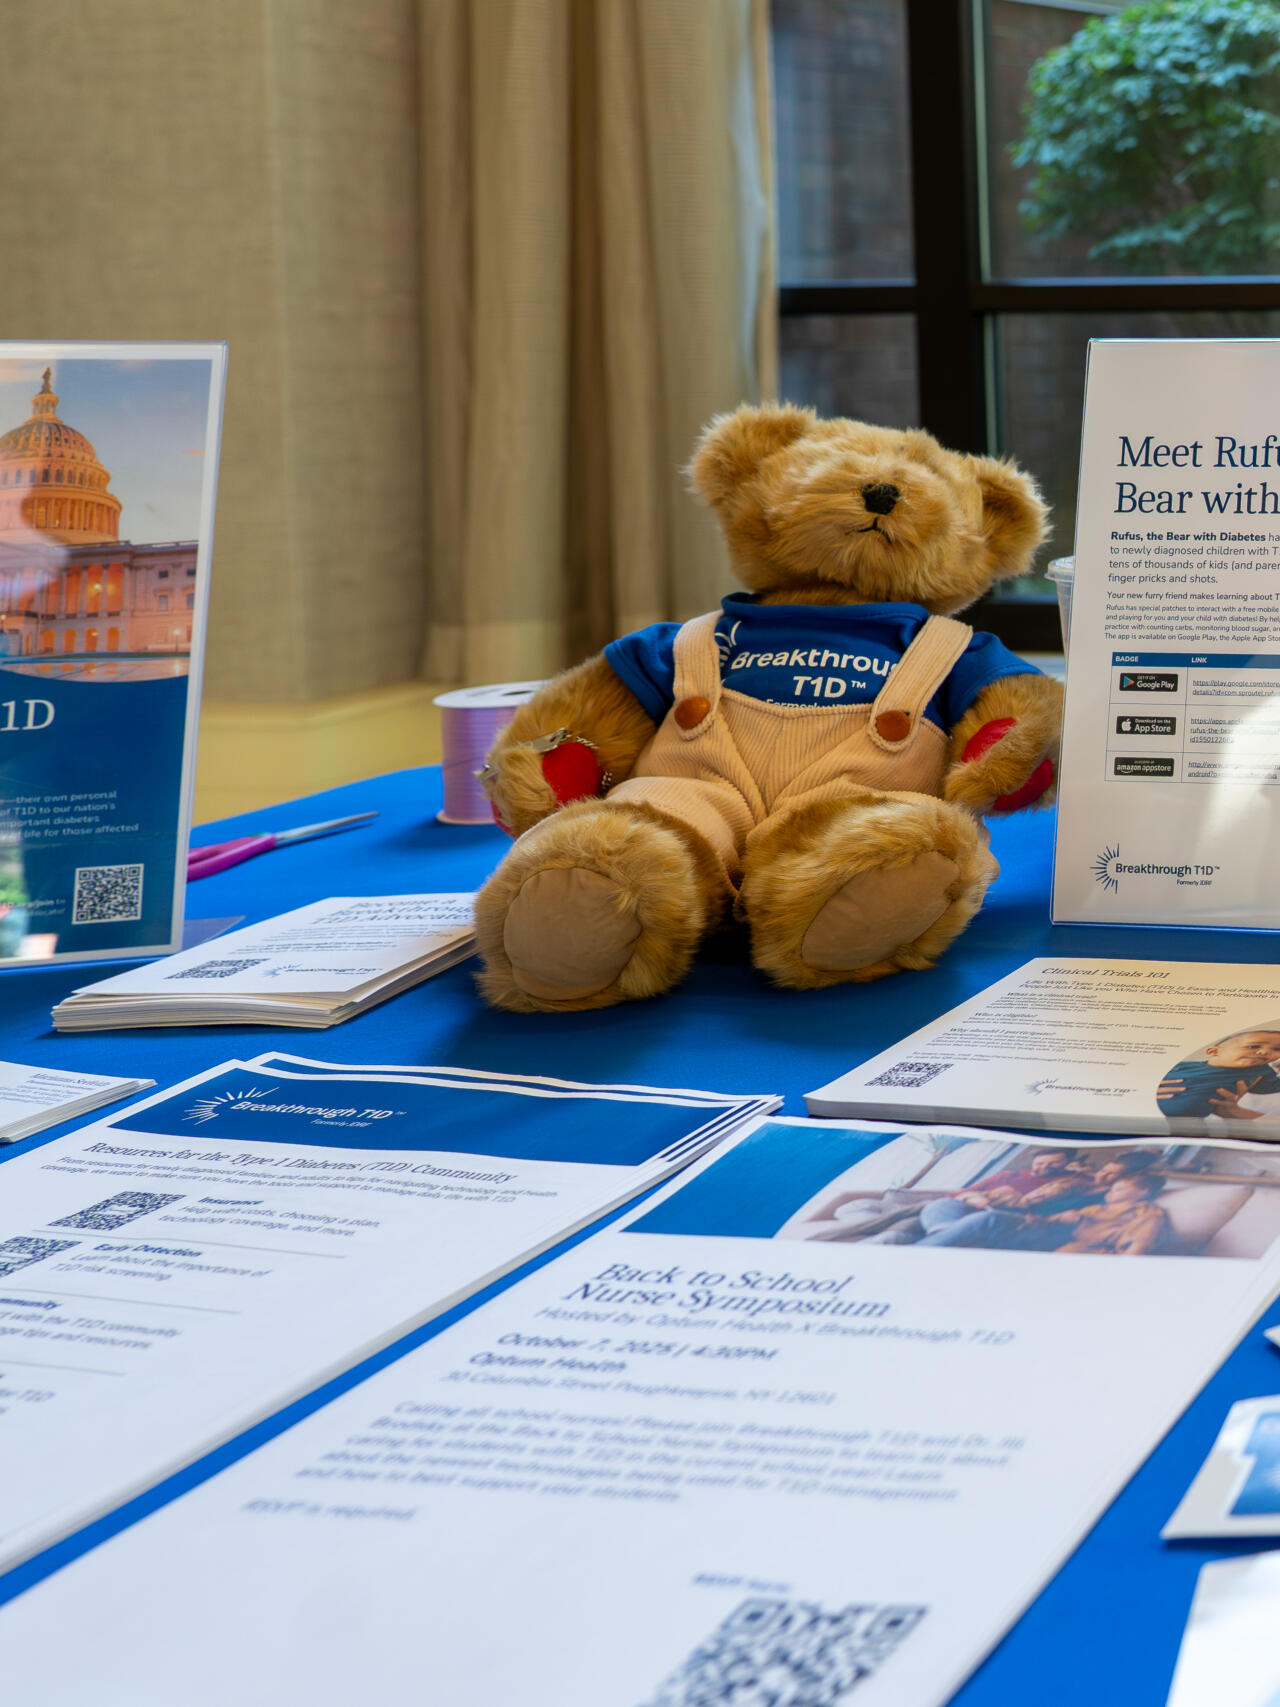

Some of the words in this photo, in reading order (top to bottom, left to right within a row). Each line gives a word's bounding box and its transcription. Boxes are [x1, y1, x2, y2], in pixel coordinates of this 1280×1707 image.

[1116, 435, 1203, 468] Meet
[1113, 481, 1193, 514] Bear
[1200, 481, 1280, 514] with
[1110, 530, 1144, 542] Rufus,
[1145, 531, 1164, 541] the
[1165, 531, 1191, 541] Bear
[1192, 531, 1217, 541] with
[1219, 531, 1266, 542] Diabetes
[1109, 545, 1120, 555] to
[1121, 544, 1152, 557] newly
[1153, 545, 1204, 557] diagnosed
[1205, 545, 1245, 556] children
[1247, 545, 1269, 556] with
[1106, 590, 1125, 599] Your
[1144, 591, 1164, 601] furry
[1164, 591, 1188, 600] friend
[1188, 591, 1215, 600] makes
[1215, 592, 1248, 602] learning
[1249, 592, 1273, 601] about
[731, 649, 898, 677] Breakthrou
[44, 794, 68, 803] own
[70, 790, 118, 802] personal
[39, 807, 51, 815] to
[1114, 862, 1192, 878] Breakthrough
[1042, 967, 1101, 976] Clinical
[1101, 969, 1143, 978] Trials
[1143, 971, 1171, 979] 101
[230, 1101, 358, 1119] Breakthrough
[81, 1142, 167, 1158] Resources
[170, 1149, 202, 1160] for
[199, 1151, 230, 1162] the
[229, 1153, 274, 1166] Type
[289, 1158, 361, 1170] Diabetes
[411, 1163, 519, 1183] Community
[593, 1262, 682, 1286] Back
[686, 1271, 727, 1289] to
[728, 1269, 855, 1294] School
[563, 1282, 677, 1307] Nurse
[676, 1290, 893, 1320] Symposium
